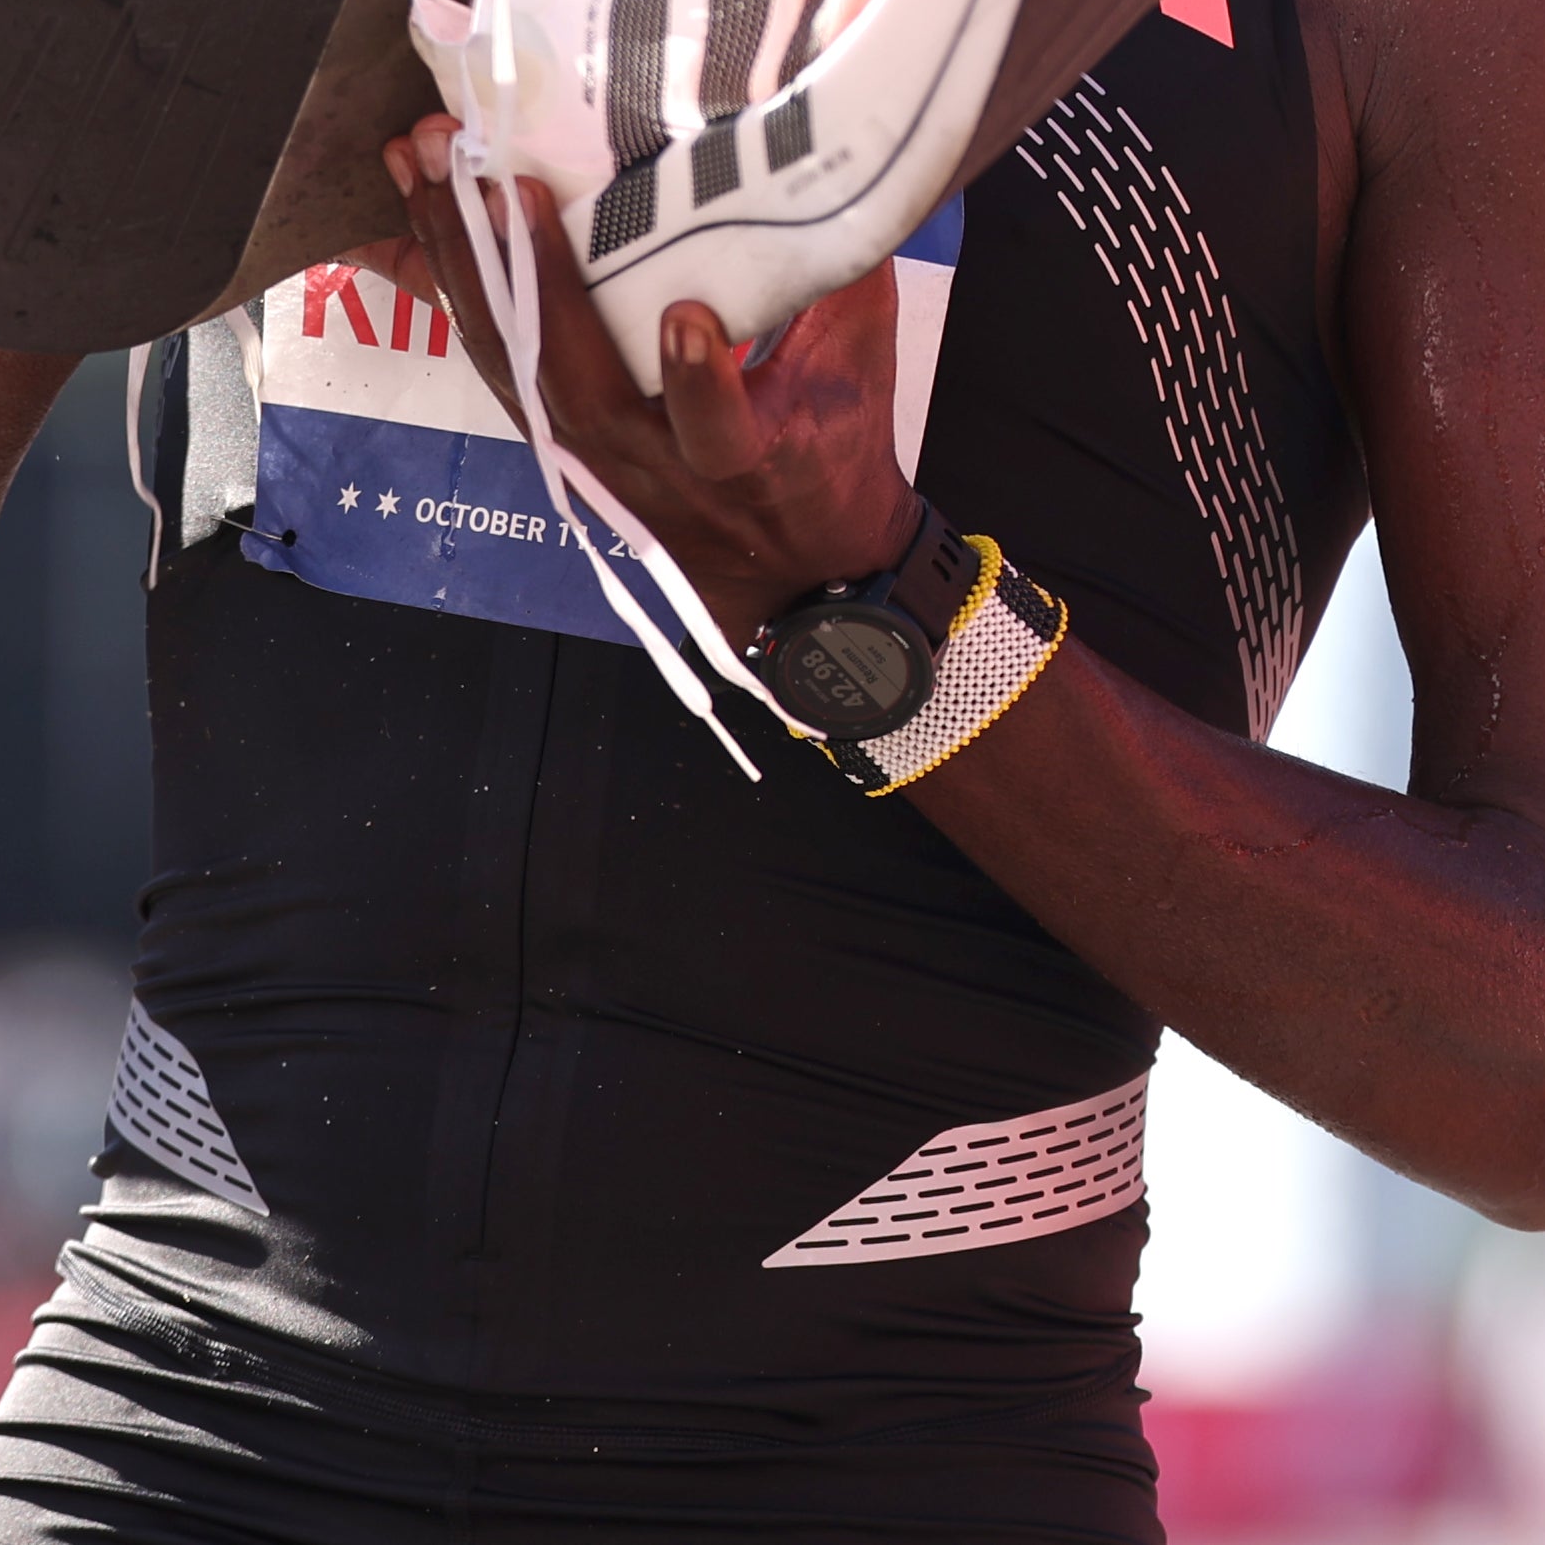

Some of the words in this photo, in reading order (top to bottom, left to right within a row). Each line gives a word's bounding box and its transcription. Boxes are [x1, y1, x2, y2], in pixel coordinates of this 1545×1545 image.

[415, 497, 546, 544] OCTOBER
[801, 649, 864, 707] 42.98
[840, 647, 879, 684] Resume
